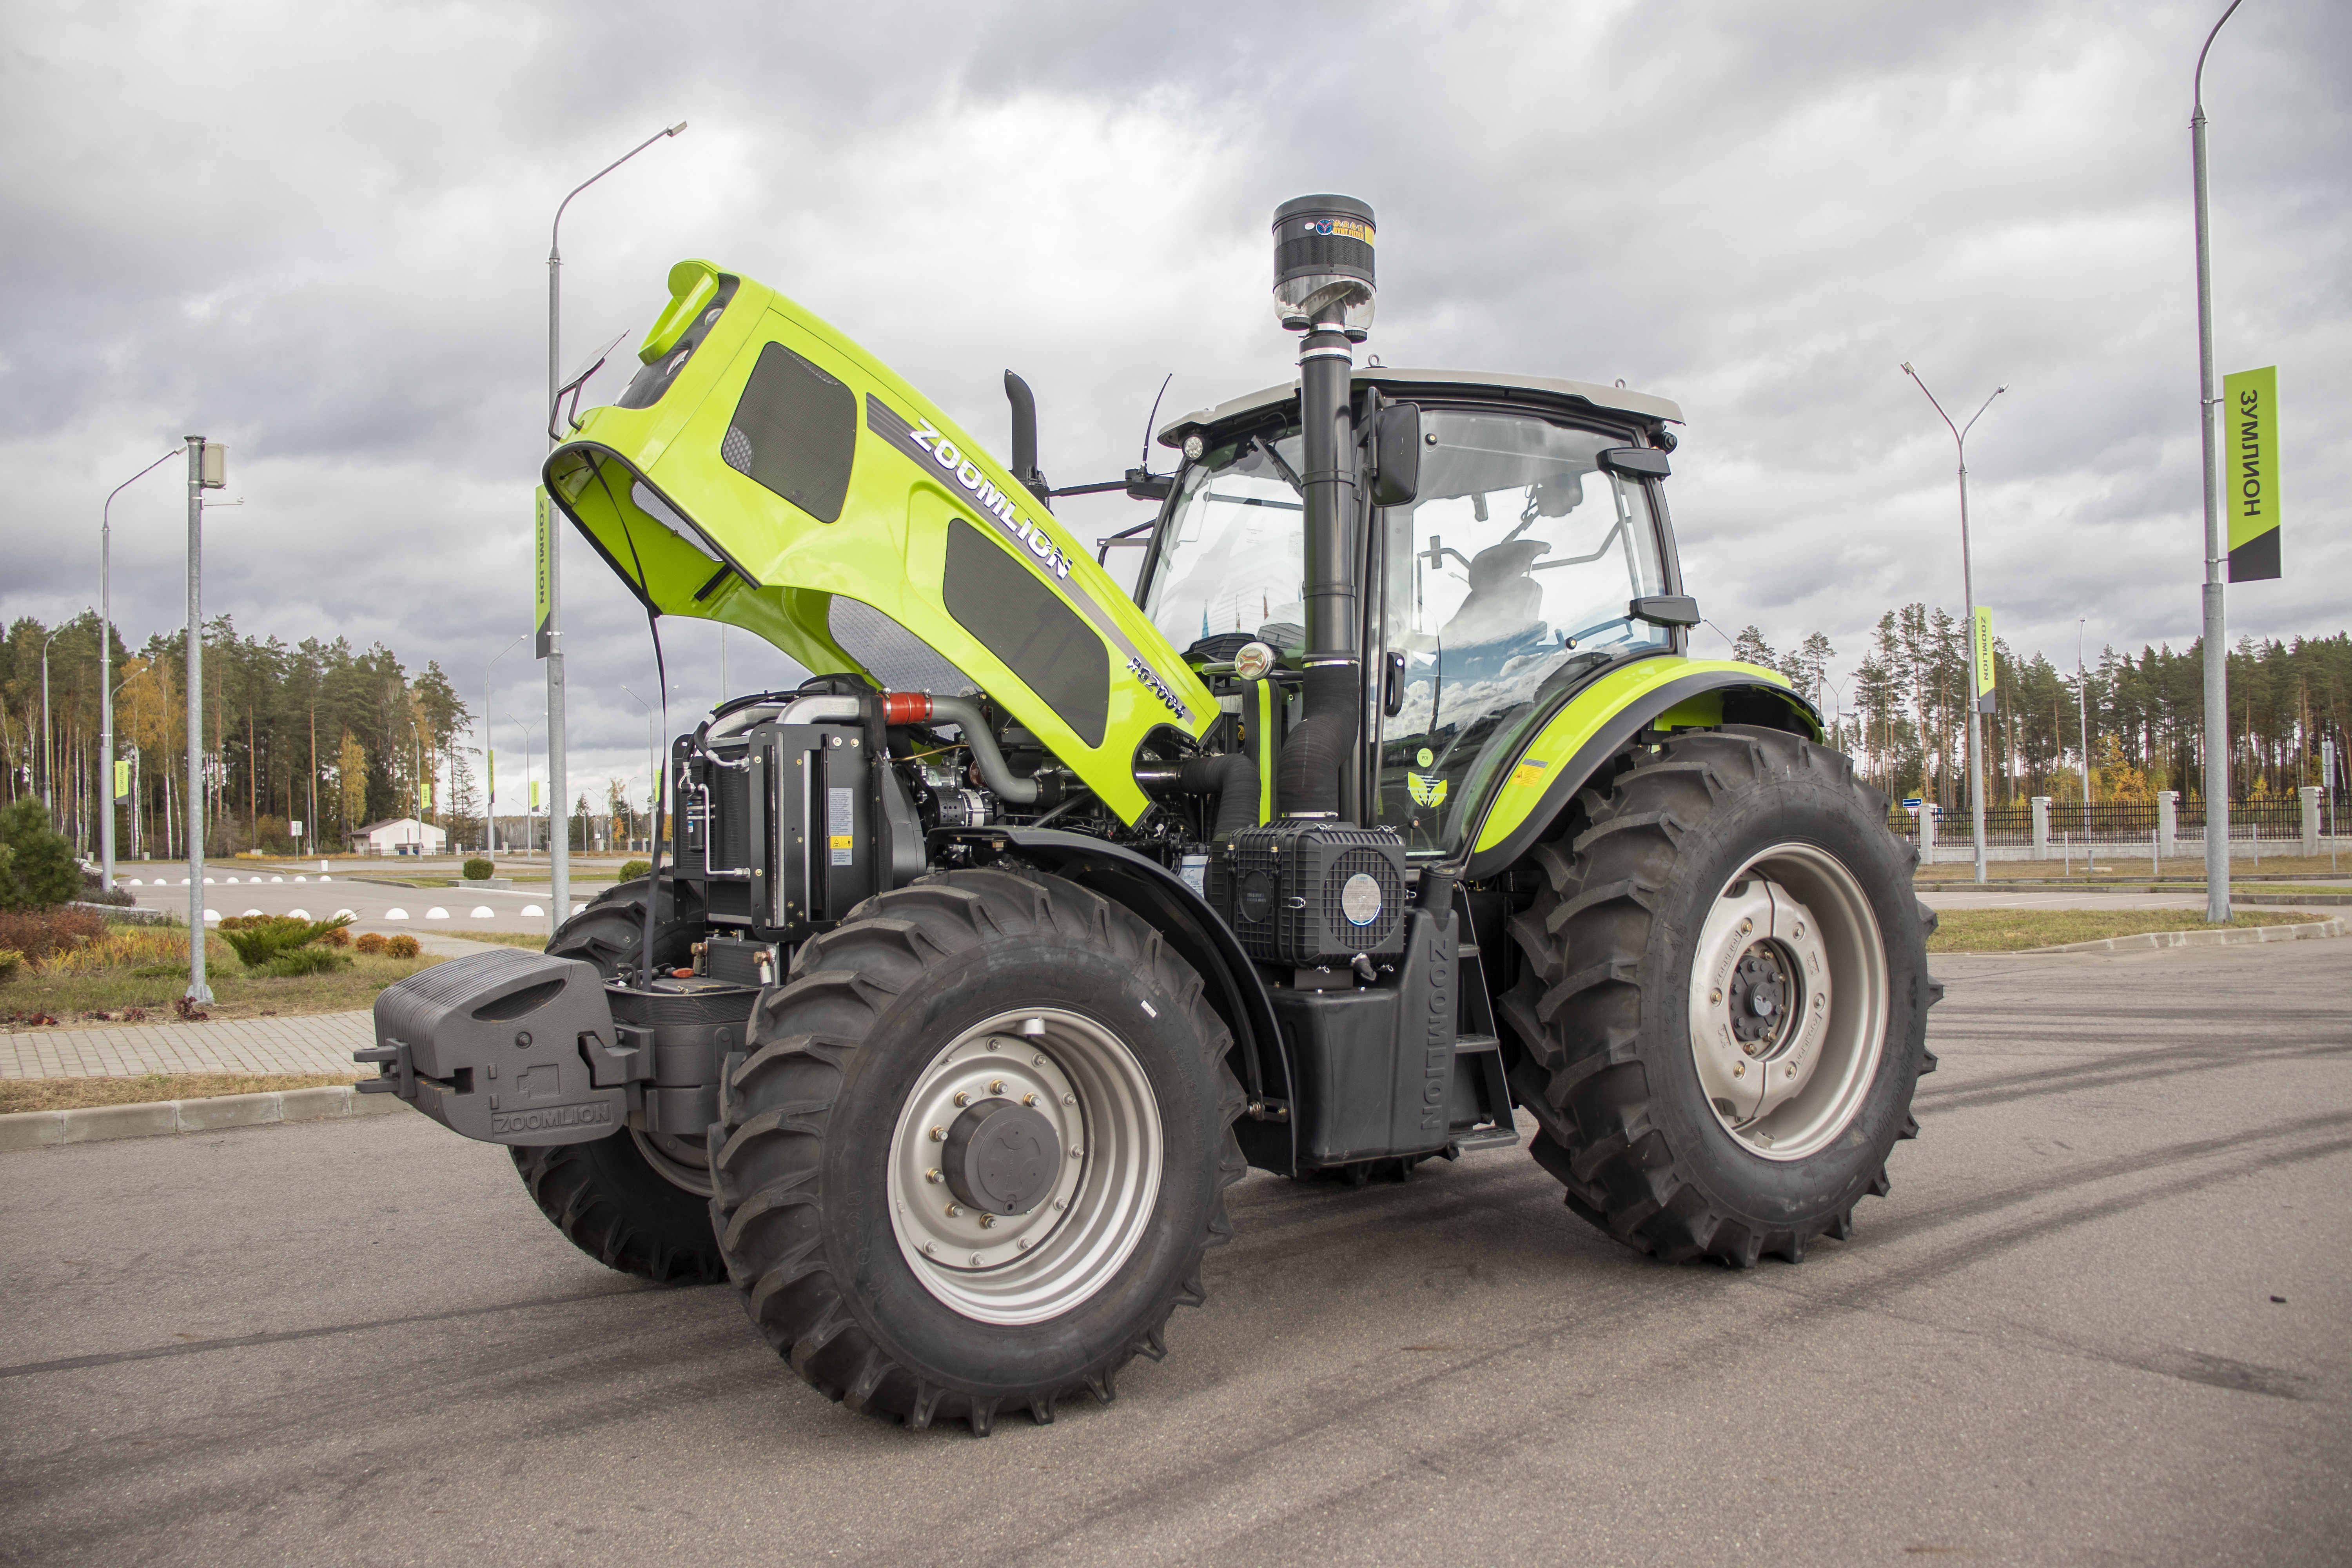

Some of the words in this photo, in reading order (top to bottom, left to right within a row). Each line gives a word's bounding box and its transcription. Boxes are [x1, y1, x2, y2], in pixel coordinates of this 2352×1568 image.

[1349, 229, 1363, 240] FILTER
[2241, 389, 2261, 516] ЗУМЛИОН
[909, 418, 1073, 580] ZOOMLION
[1126, 656, 1186, 719] RG2004
[1715, 933, 1740, 985] ZOOMLION
[1420, 939, 1449, 1130] ZOOMLION
[1796, 1017, 1819, 1065] ZOOMLION
[494, 1102, 610, 1133] ZOOMLION
